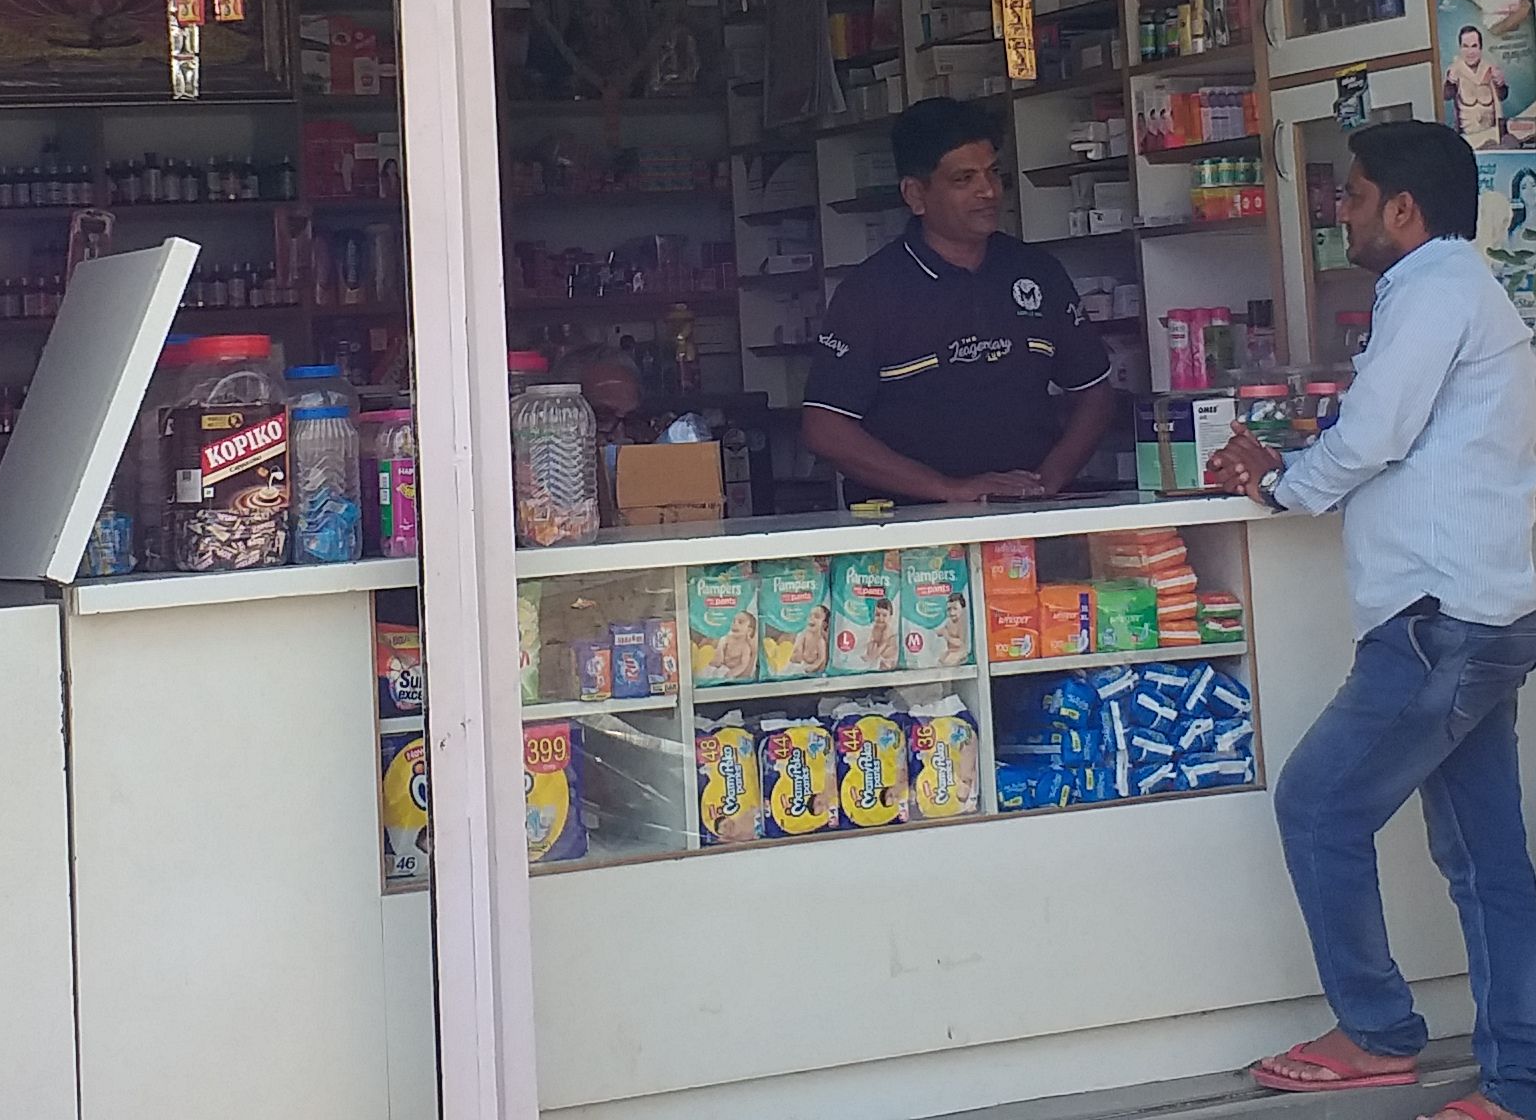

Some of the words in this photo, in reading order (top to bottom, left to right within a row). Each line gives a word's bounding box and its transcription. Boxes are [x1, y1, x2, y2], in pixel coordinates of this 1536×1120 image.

[203, 419, 283, 469] KOPIKO
[773, 576, 816, 593] Pampers
[846, 567, 891, 586] Pampers
[907, 565, 957, 584] Pampers
[697, 578, 742, 596] Pampers
[771, 734, 791, 759] 44
[843, 729, 862, 754] 44
[917, 724, 934, 748] 36
[527, 737, 567, 765] 399
[700, 738, 717, 763] 48
[396, 855, 416, 871] 46
